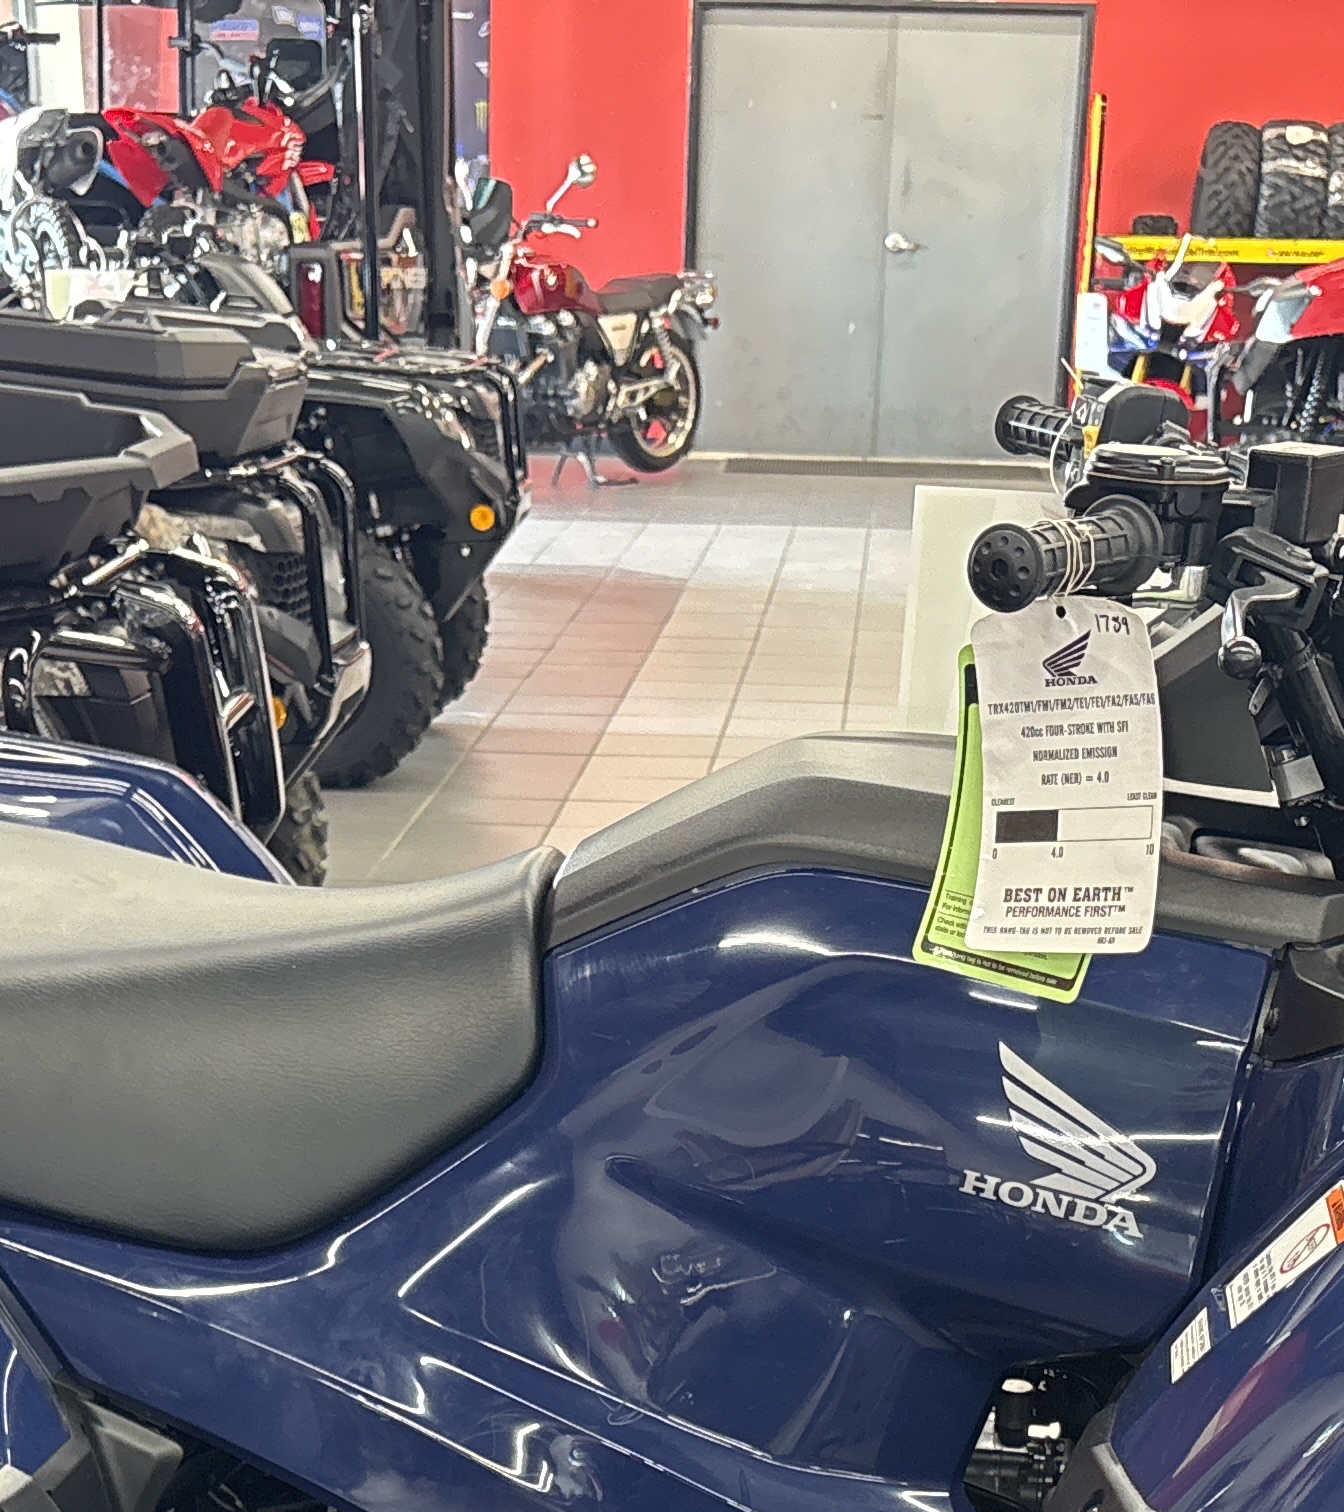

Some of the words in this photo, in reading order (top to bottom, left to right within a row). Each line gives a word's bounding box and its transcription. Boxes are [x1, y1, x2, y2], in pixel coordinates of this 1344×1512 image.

[1044, 675, 1098, 687] HONDA
[1045, 722, 1094, 737] FOUR-STROKE
[1096, 721, 1115, 733] WITH
[1117, 721, 1129, 733] SFI
[1033, 748, 1080, 762] NORMALIZED
[1082, 746, 1118, 759] EMISSION
[1041, 773, 1058, 785] RATE
[1061, 772, 1082, 785] (NER)
[1096, 771, 1110, 784] 4.0
[1051, 846, 1064, 859] 4.0
[1145, 844, 1155, 856] 10
[1003, 888, 1043, 903] BEST
[1047, 887, 1068, 903] ON
[1005, 905, 1082, 918] PERFORMANCE
[958, 1169, 1144, 1239] HONDA
